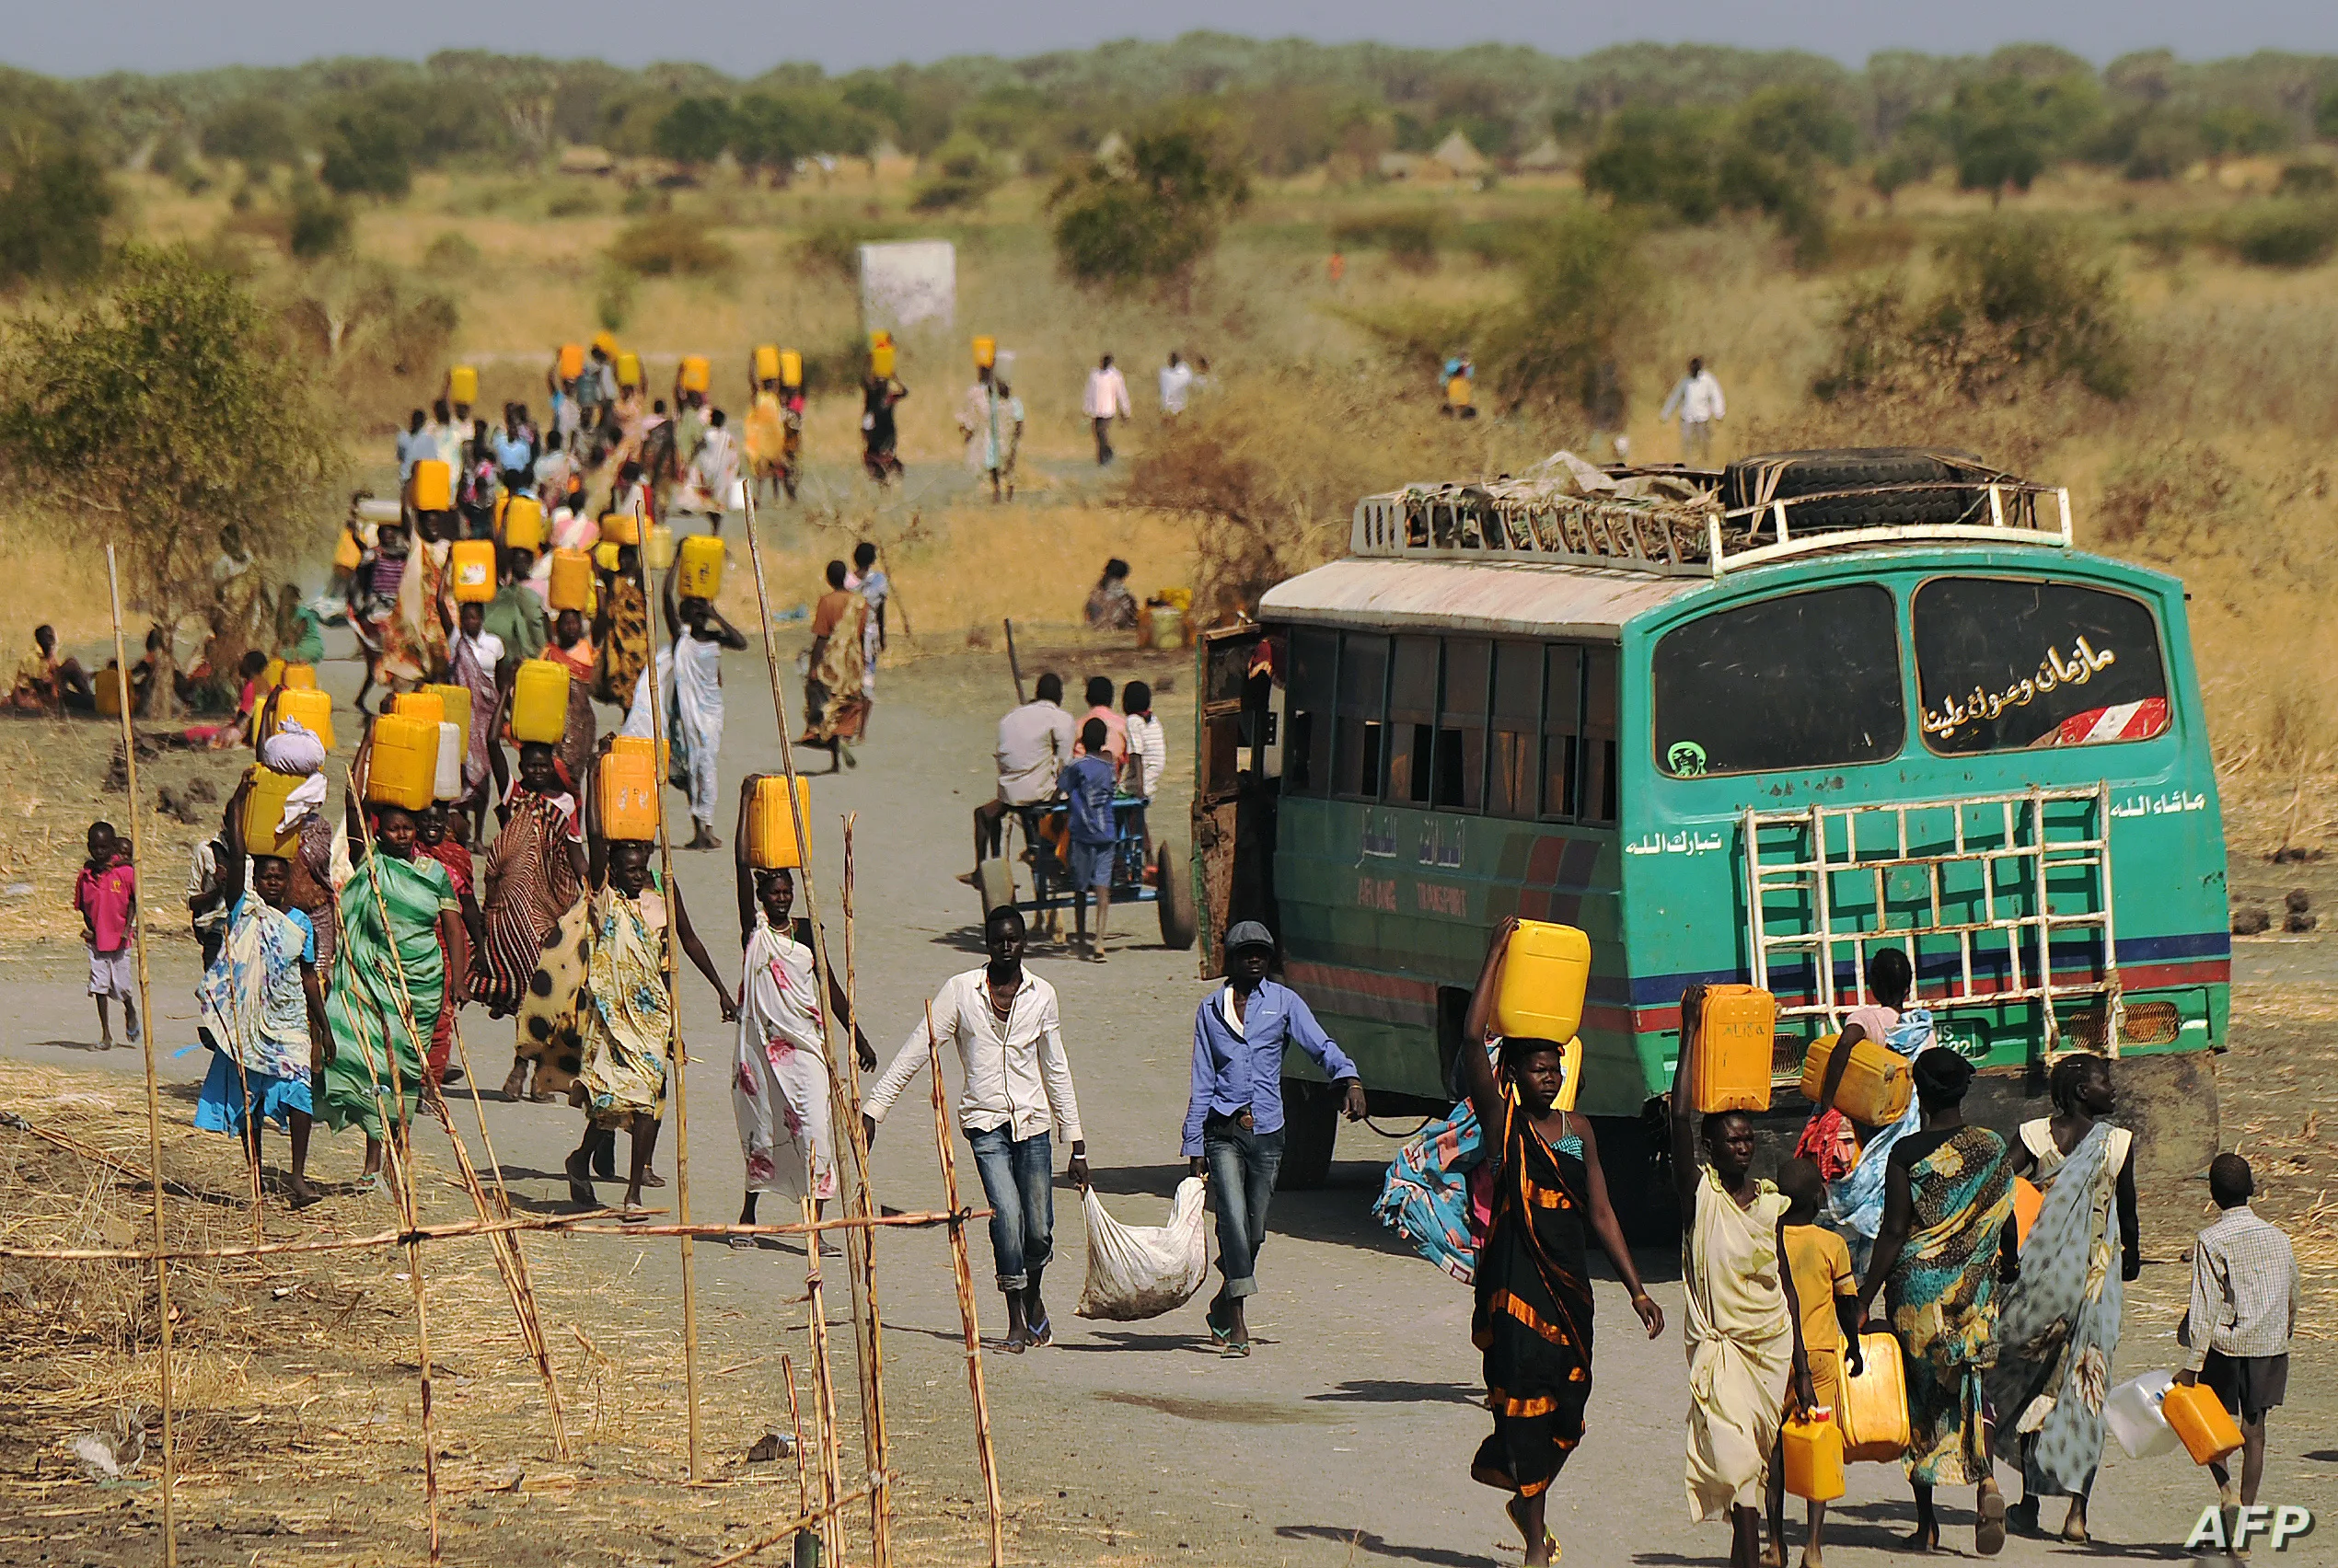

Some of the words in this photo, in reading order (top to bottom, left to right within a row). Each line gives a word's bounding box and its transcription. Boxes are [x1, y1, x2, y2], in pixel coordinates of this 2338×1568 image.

[2110, 794, 2151, 817] الله
[1625, 832, 1666, 855] الله
[1666, 830, 1722, 856] تبارك
